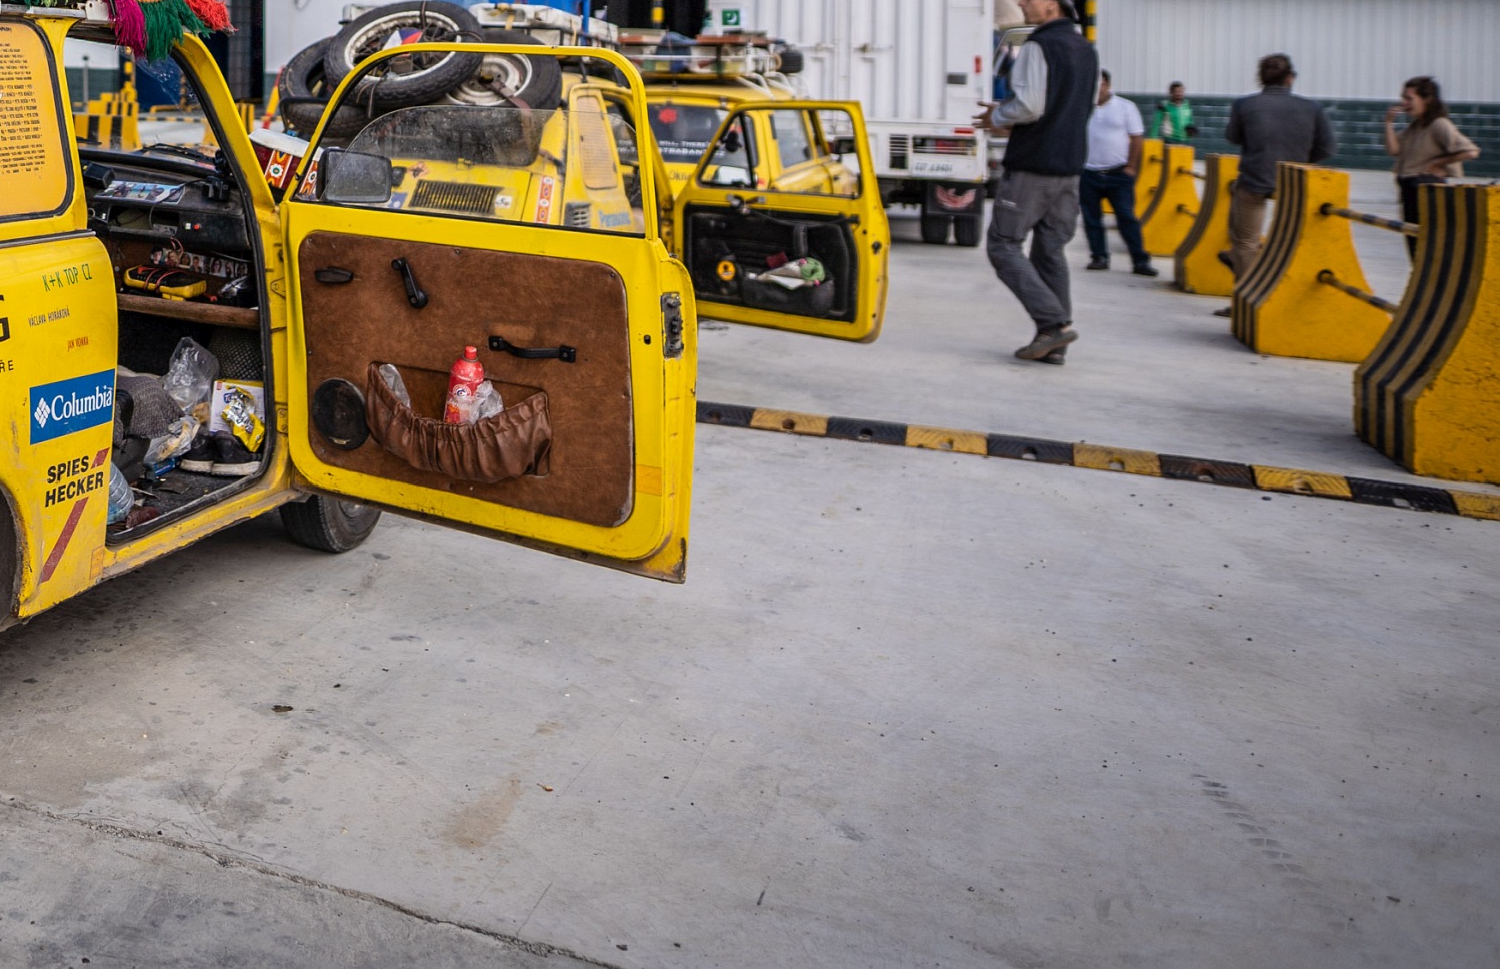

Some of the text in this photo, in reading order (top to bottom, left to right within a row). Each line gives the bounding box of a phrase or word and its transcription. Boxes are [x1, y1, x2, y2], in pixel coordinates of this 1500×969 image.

[42, 263, 93, 292] K+K TOP CZ
[51, 385, 113, 421] Columbia
[46, 455, 90, 484] SPIES
[44, 471, 104, 508] HECKER
